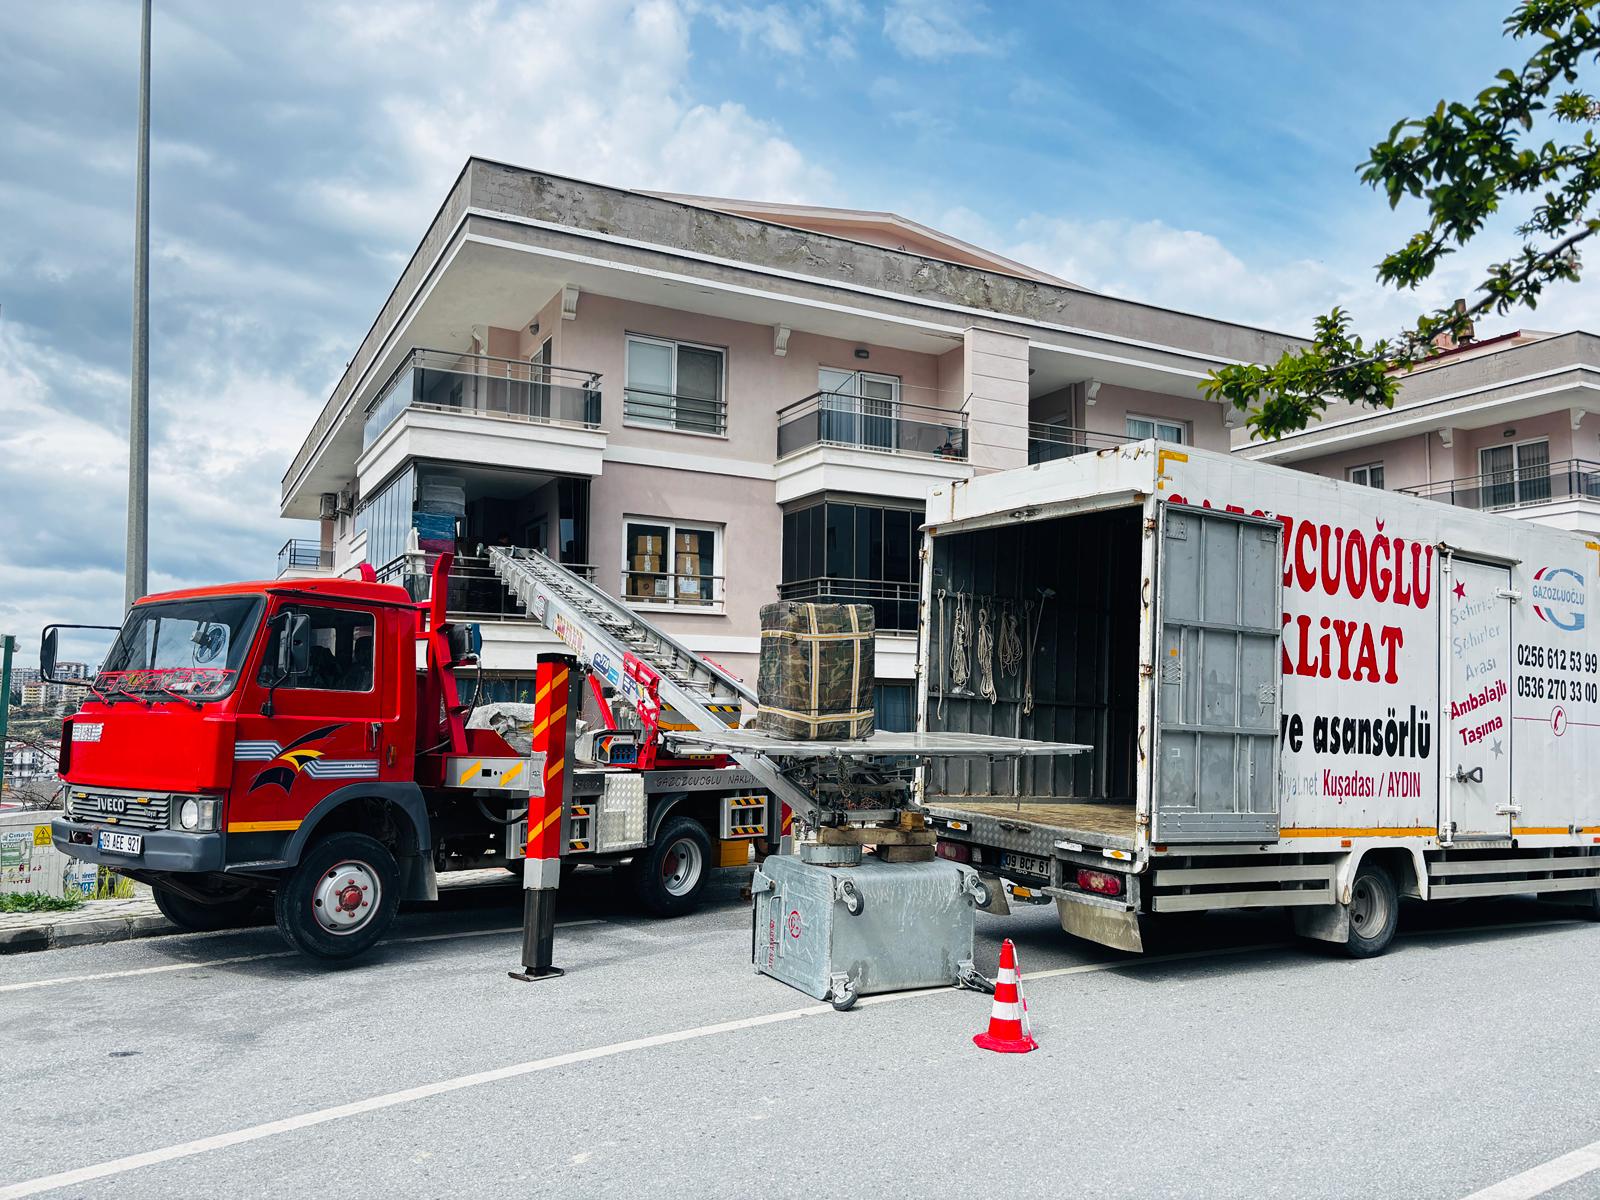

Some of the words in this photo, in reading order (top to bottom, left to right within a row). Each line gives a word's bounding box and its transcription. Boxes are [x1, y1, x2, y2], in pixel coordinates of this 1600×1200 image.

[1517, 643, 1545, 668] 0256
[1547, 647, 1567, 671] 612
[1569, 650, 1582, 673] 53
[1584, 652, 1598, 674] 99
[1450, 679, 1508, 721] Ambalajlı
[1517, 675, 1545, 699] 0536
[1547, 678, 1567, 701] 270
[1569, 680, 1582, 702] 33
[1584, 682, 1598, 704] 00
[1313, 704, 1431, 759] asansörlü
[1458, 715, 1504, 746] Taşıma
[1323, 768, 1375, 805] Kuşadası
[1387, 771, 1421, 798] AYDIN
[97, 797, 125, 813] IVECO
[112, 834, 125, 849] AEE
[127, 835, 140, 852] 921
[1006, 854, 1017, 868] 09
[1020, 857, 1036, 871] BCF
[1038, 860, 1049, 875] 61
